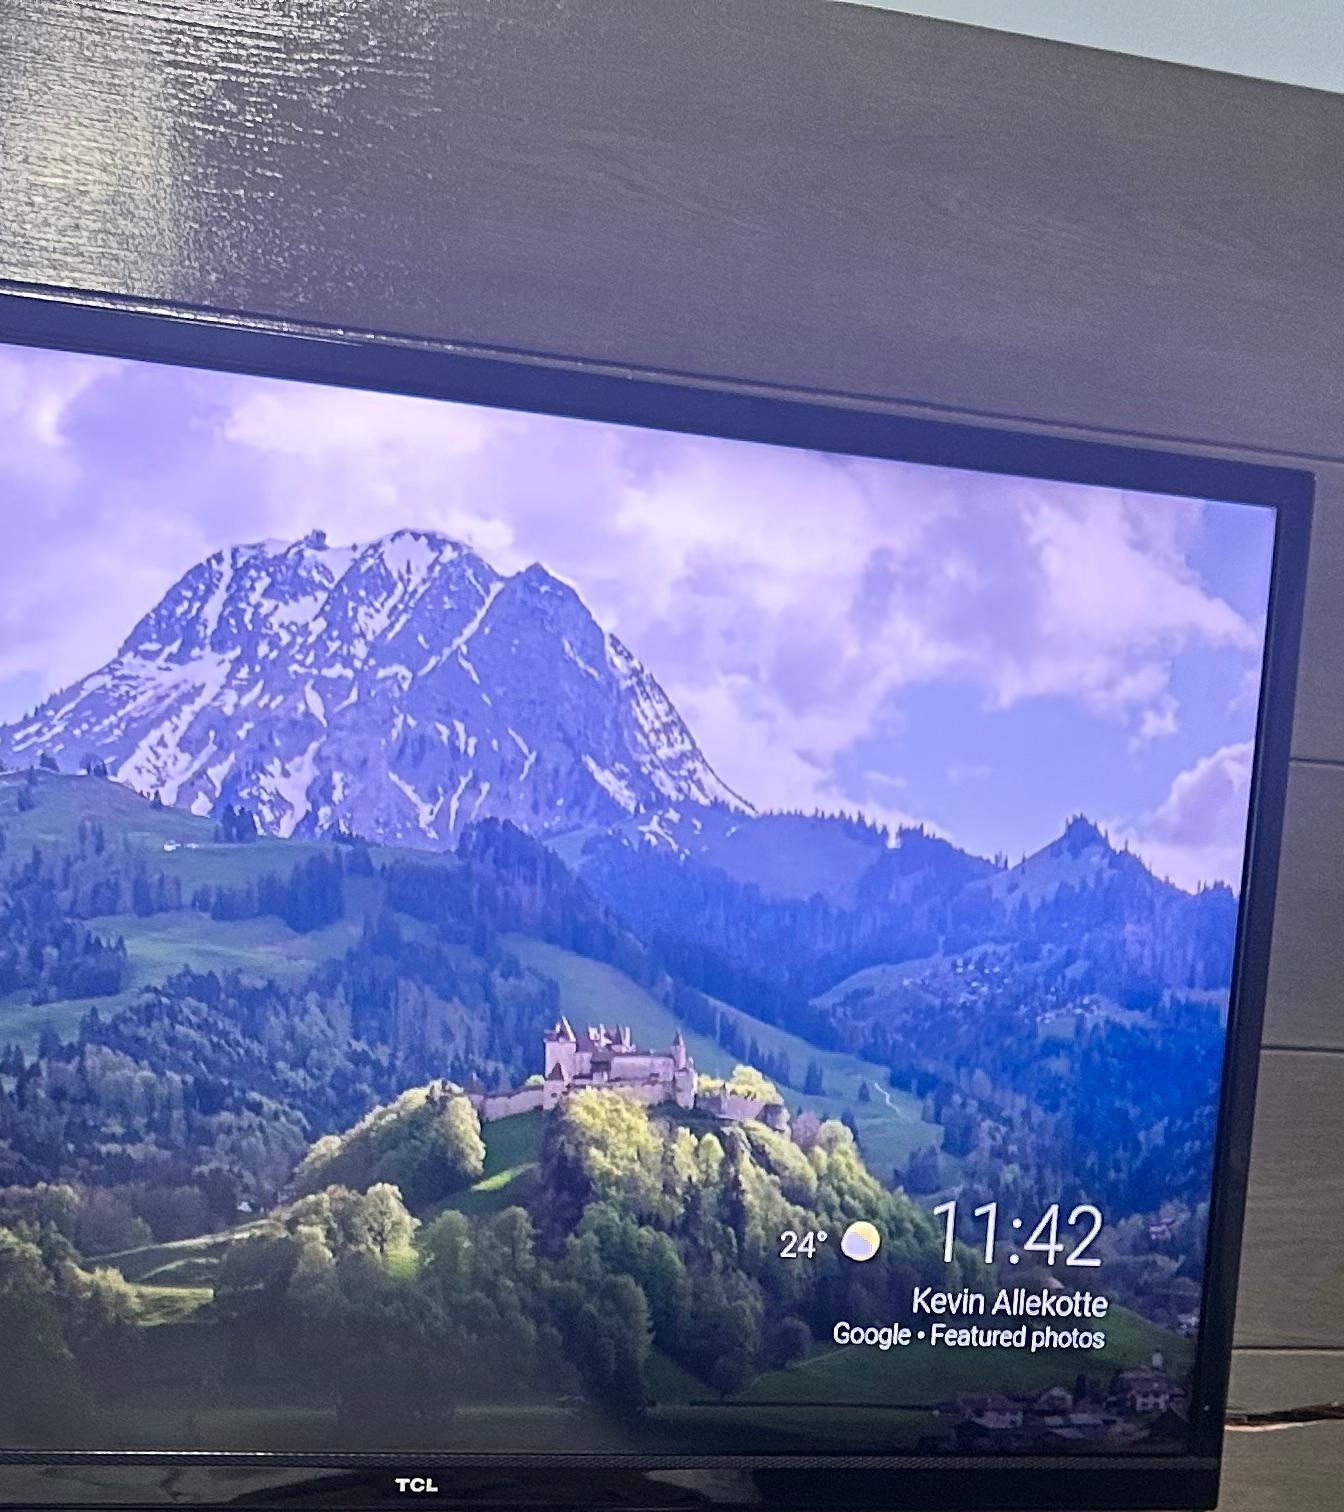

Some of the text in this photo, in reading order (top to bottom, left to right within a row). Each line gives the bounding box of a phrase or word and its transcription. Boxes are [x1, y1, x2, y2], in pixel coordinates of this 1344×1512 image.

[779, 1229, 828, 1259] 24°
[933, 1200, 1104, 1268] 11:42
[912, 1286, 1109, 1319] Kevin Allekotte
[833, 1321, 1106, 1353] Google Featured photos
[394, 1477, 439, 1493] TCL
